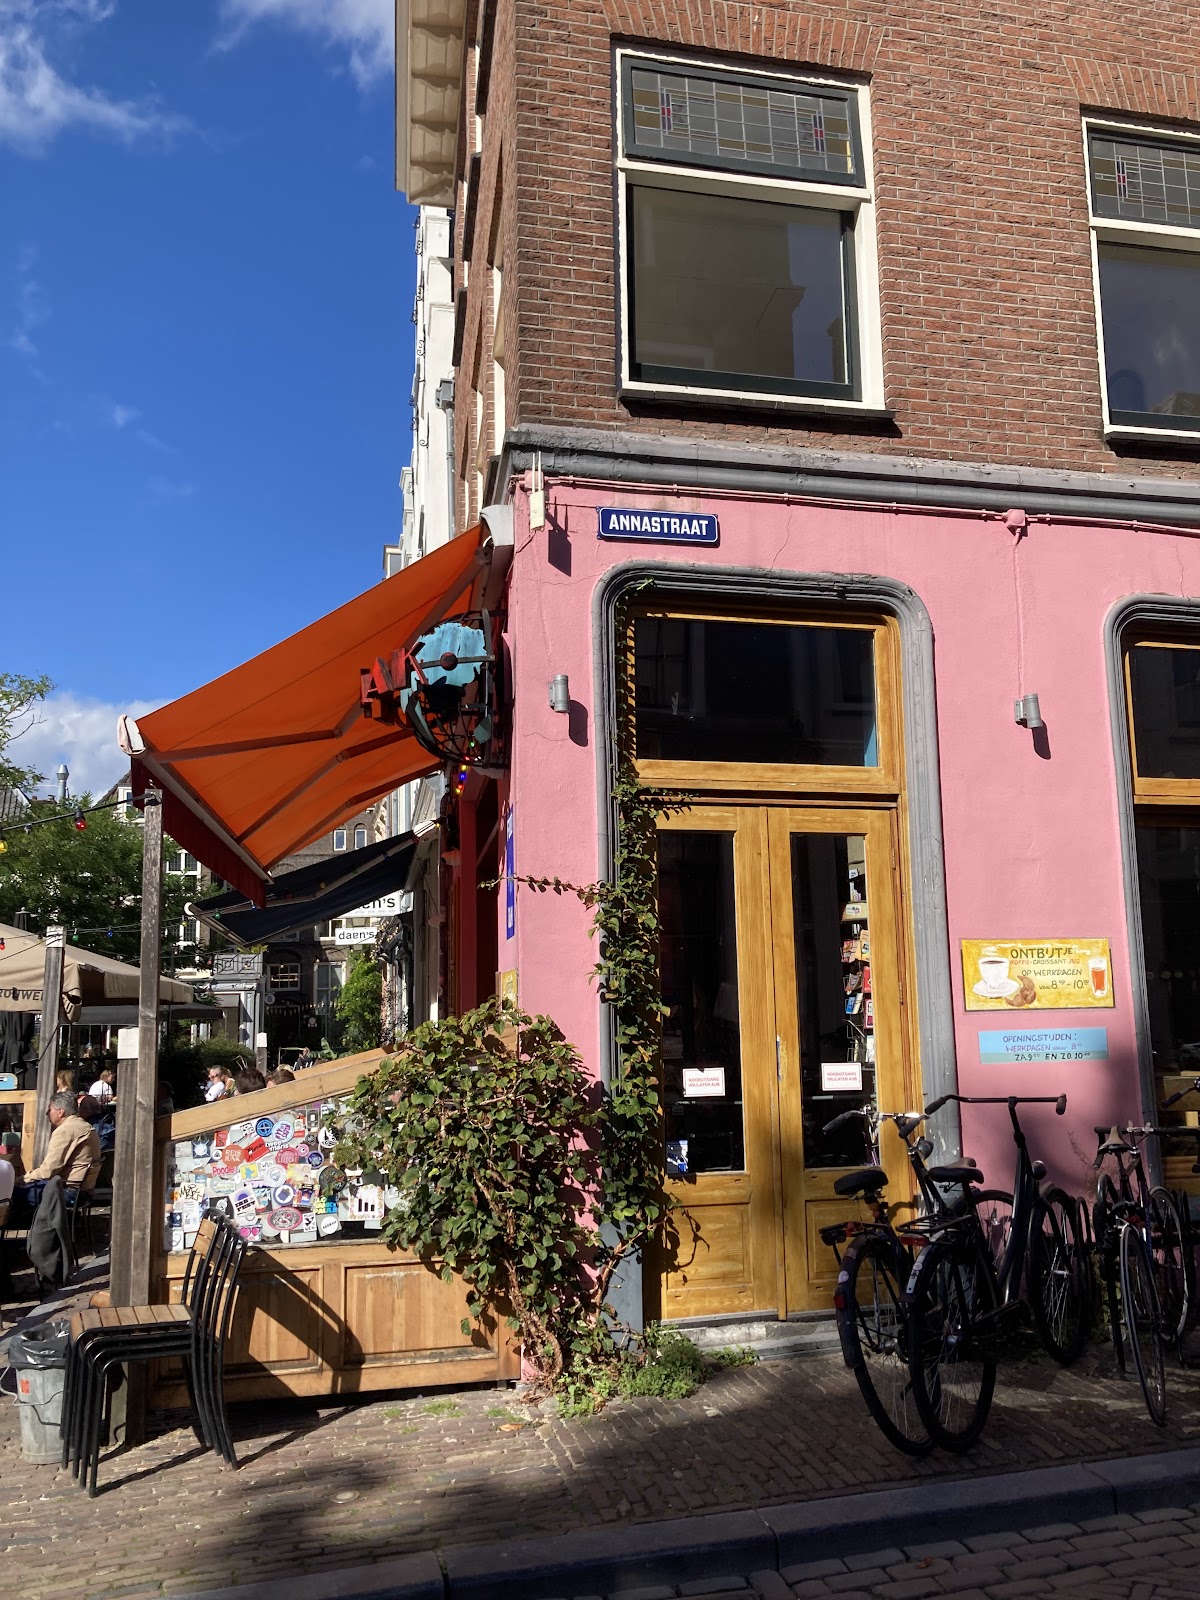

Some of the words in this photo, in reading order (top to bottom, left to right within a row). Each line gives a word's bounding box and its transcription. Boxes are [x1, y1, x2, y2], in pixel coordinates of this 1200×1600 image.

[609, 514, 708, 535] ANNASTRAAT
[1021, 969, 1032, 977] OP
[1034, 968, 1083, 977] WERKDAGEN
[1005, 1044, 1051, 1053] WERKDAGEN
